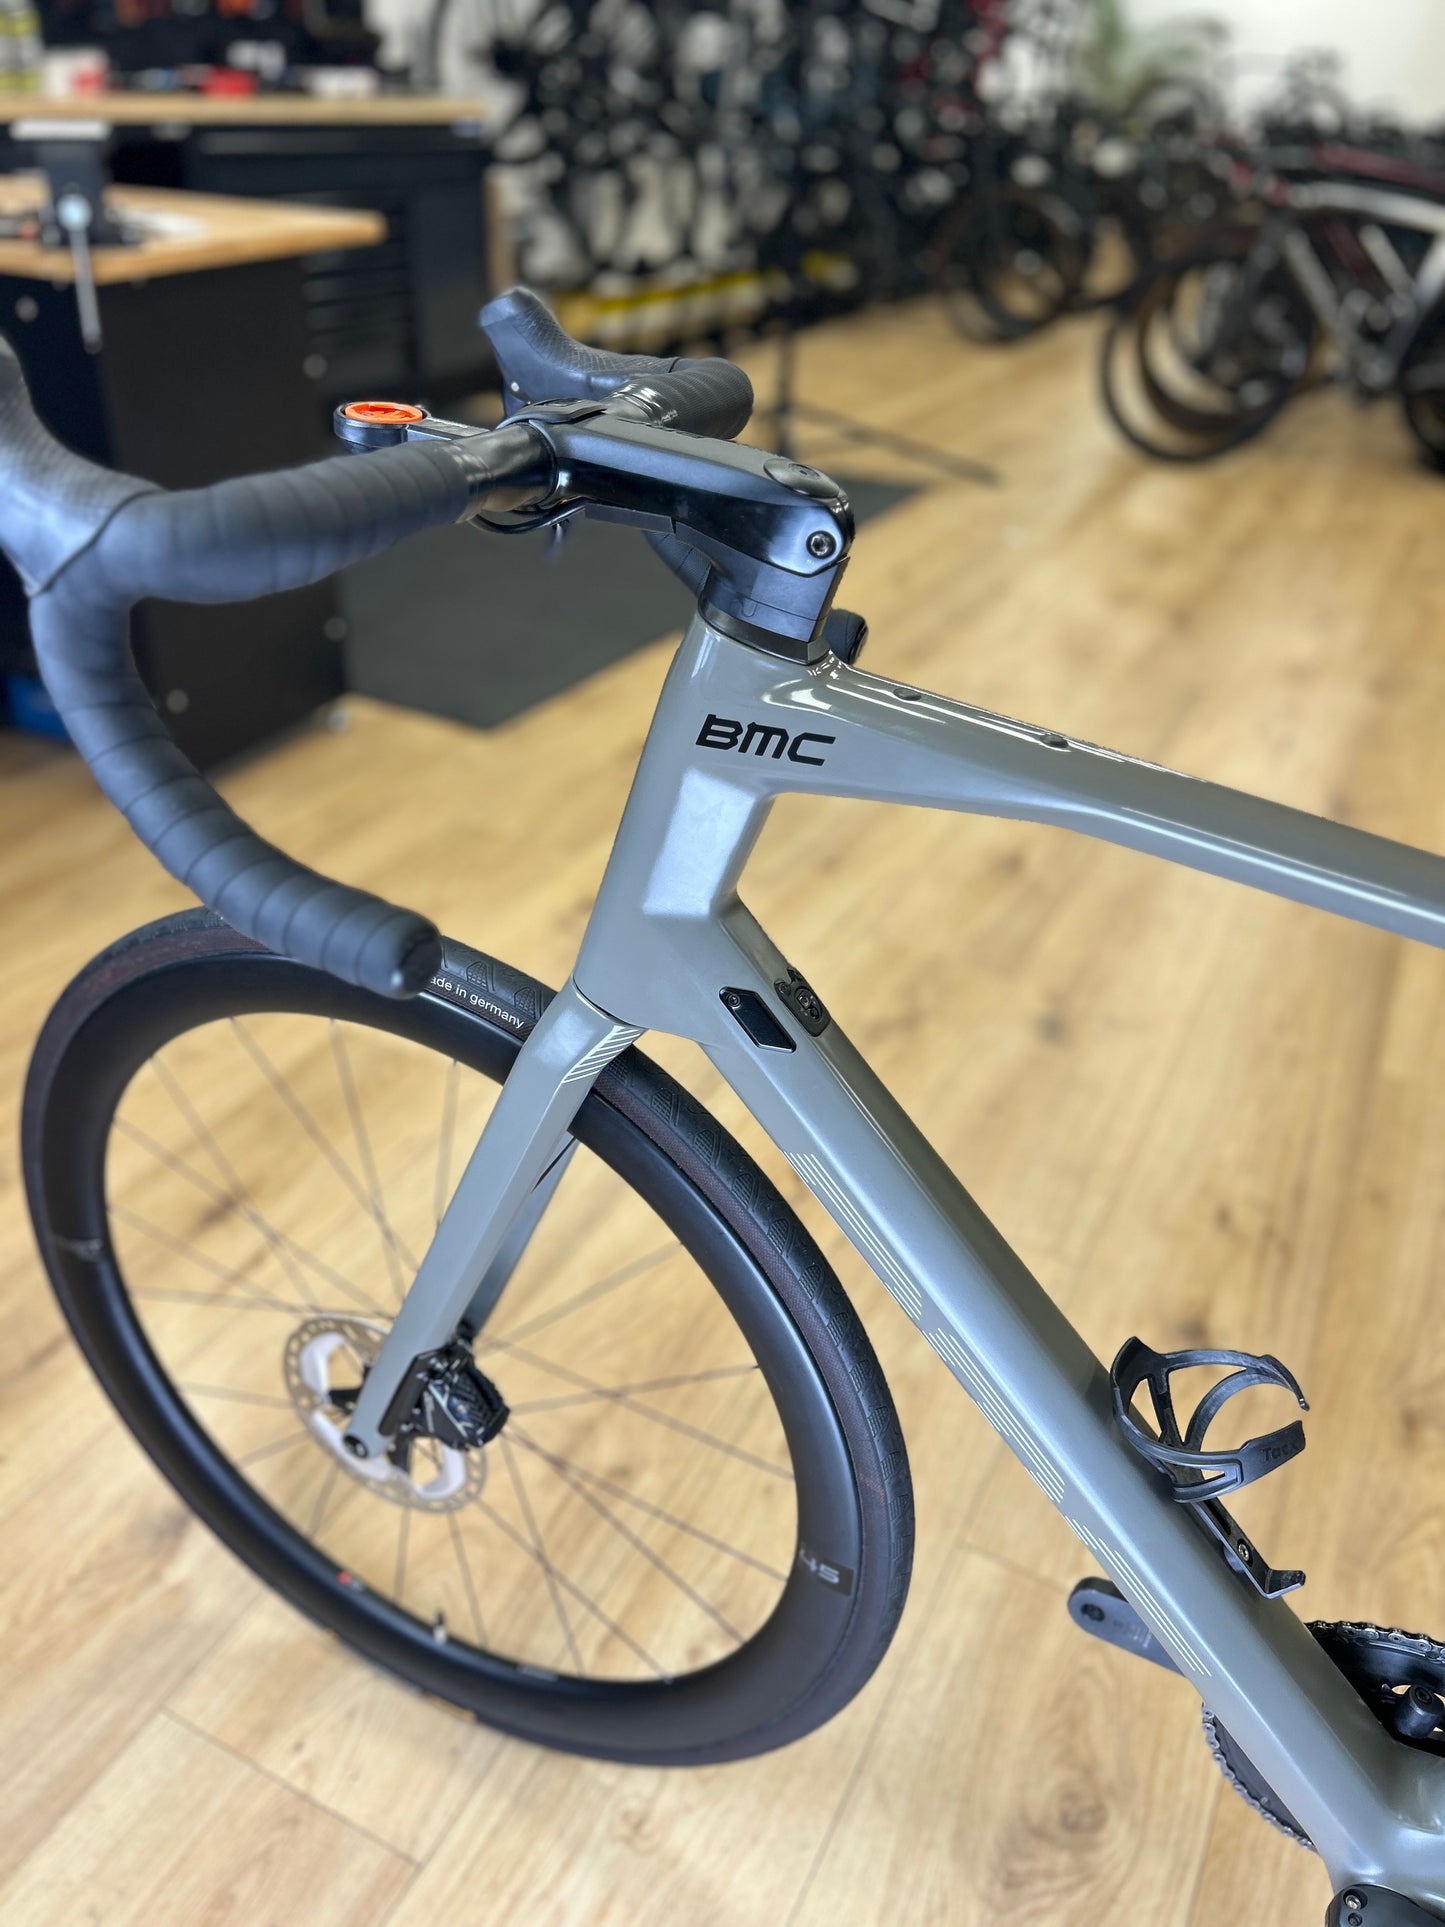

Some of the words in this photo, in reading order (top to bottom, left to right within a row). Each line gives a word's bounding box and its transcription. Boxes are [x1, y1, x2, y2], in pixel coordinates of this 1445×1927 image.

[696, 714, 836, 766] BMC
[431, 977, 452, 991] ade
[455, 984, 467, 999] in
[470, 994, 525, 1029] germany
